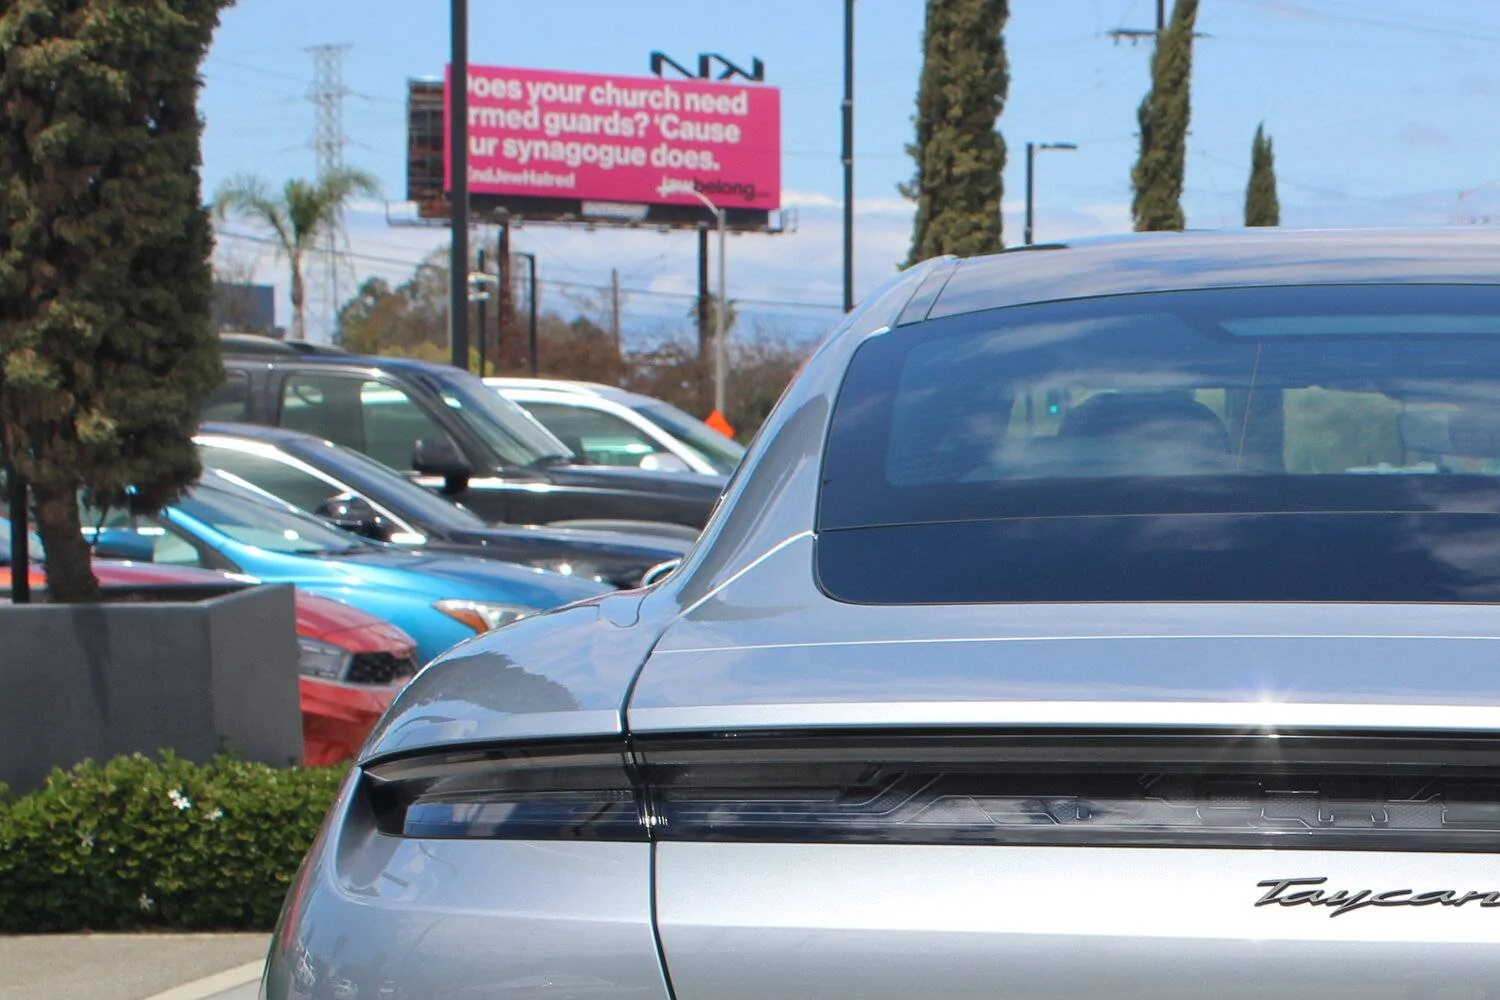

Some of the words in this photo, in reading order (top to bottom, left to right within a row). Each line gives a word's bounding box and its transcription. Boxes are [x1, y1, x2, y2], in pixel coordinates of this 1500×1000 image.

[467, 74, 522, 99] oes
[526, 81, 585, 105] your
[589, 81, 681, 111] church
[685, 90, 748, 115] need
[468, 105, 540, 129] rmed
[544, 110, 650, 136] guards?
[469, 136, 498, 157] ur
[503, 138, 647, 170] synagogue
[651, 143, 720, 171] does.
